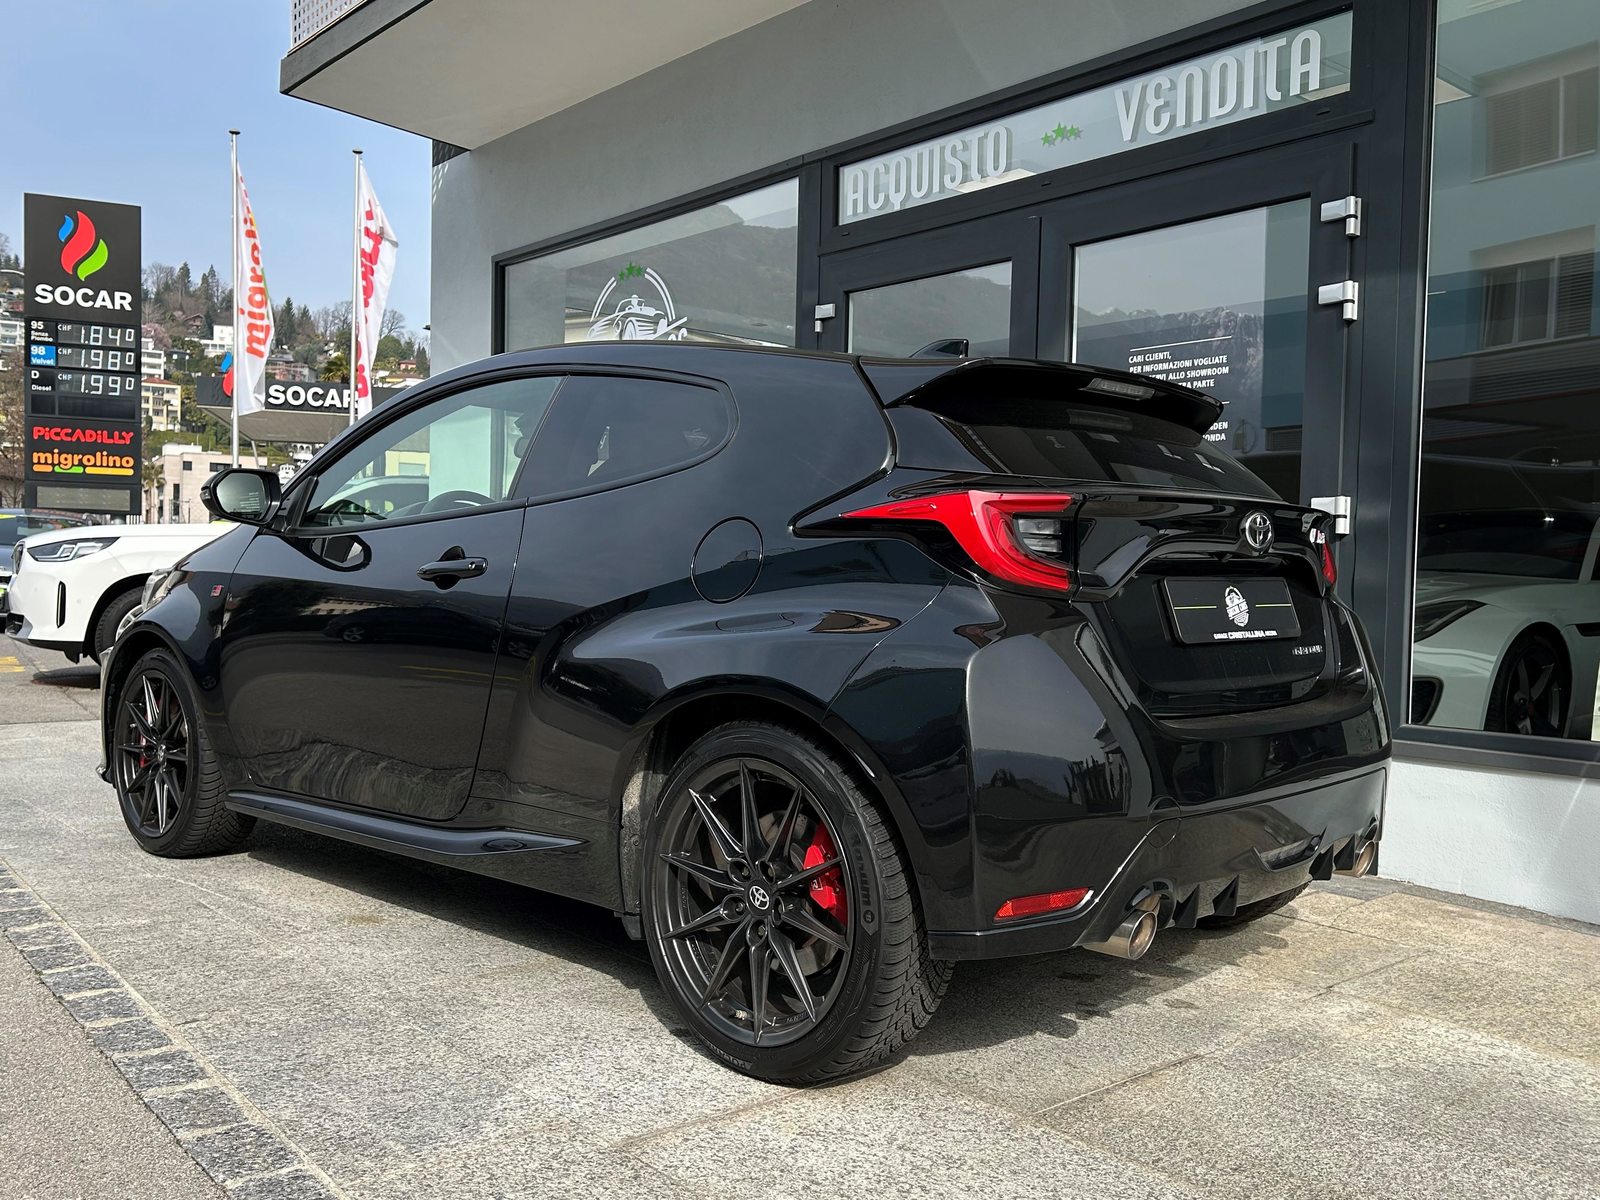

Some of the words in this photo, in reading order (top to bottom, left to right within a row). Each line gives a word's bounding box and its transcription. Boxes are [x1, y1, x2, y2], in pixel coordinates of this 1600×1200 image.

[846, 125, 1009, 217] ACQUISTO
[1114, 29, 1322, 142] VENDITA
[34, 283, 133, 311] SOCAR
[30, 321, 44, 330] 95
[30, 346, 46, 355] 98
[31, 357, 54, 365] Velvet
[1128, 354, 1144, 364] CARI
[1145, 351, 1172, 361] CLIENTI,
[1129, 365, 1142, 374] PER
[1143, 360, 1193, 373] INFORMAZIONI
[1193, 354, 1228, 367] VOGLIATE
[31, 370, 40, 379] D
[57, 373, 72, 381] CHF
[1168, 371, 1186, 381] ALLO
[1186, 366, 1230, 379] SHOWROOM
[1193, 379, 1215, 389] PARTE
[32, 426, 135, 444] PiCCADiLLY
[32, 448, 135, 469] migrolino
